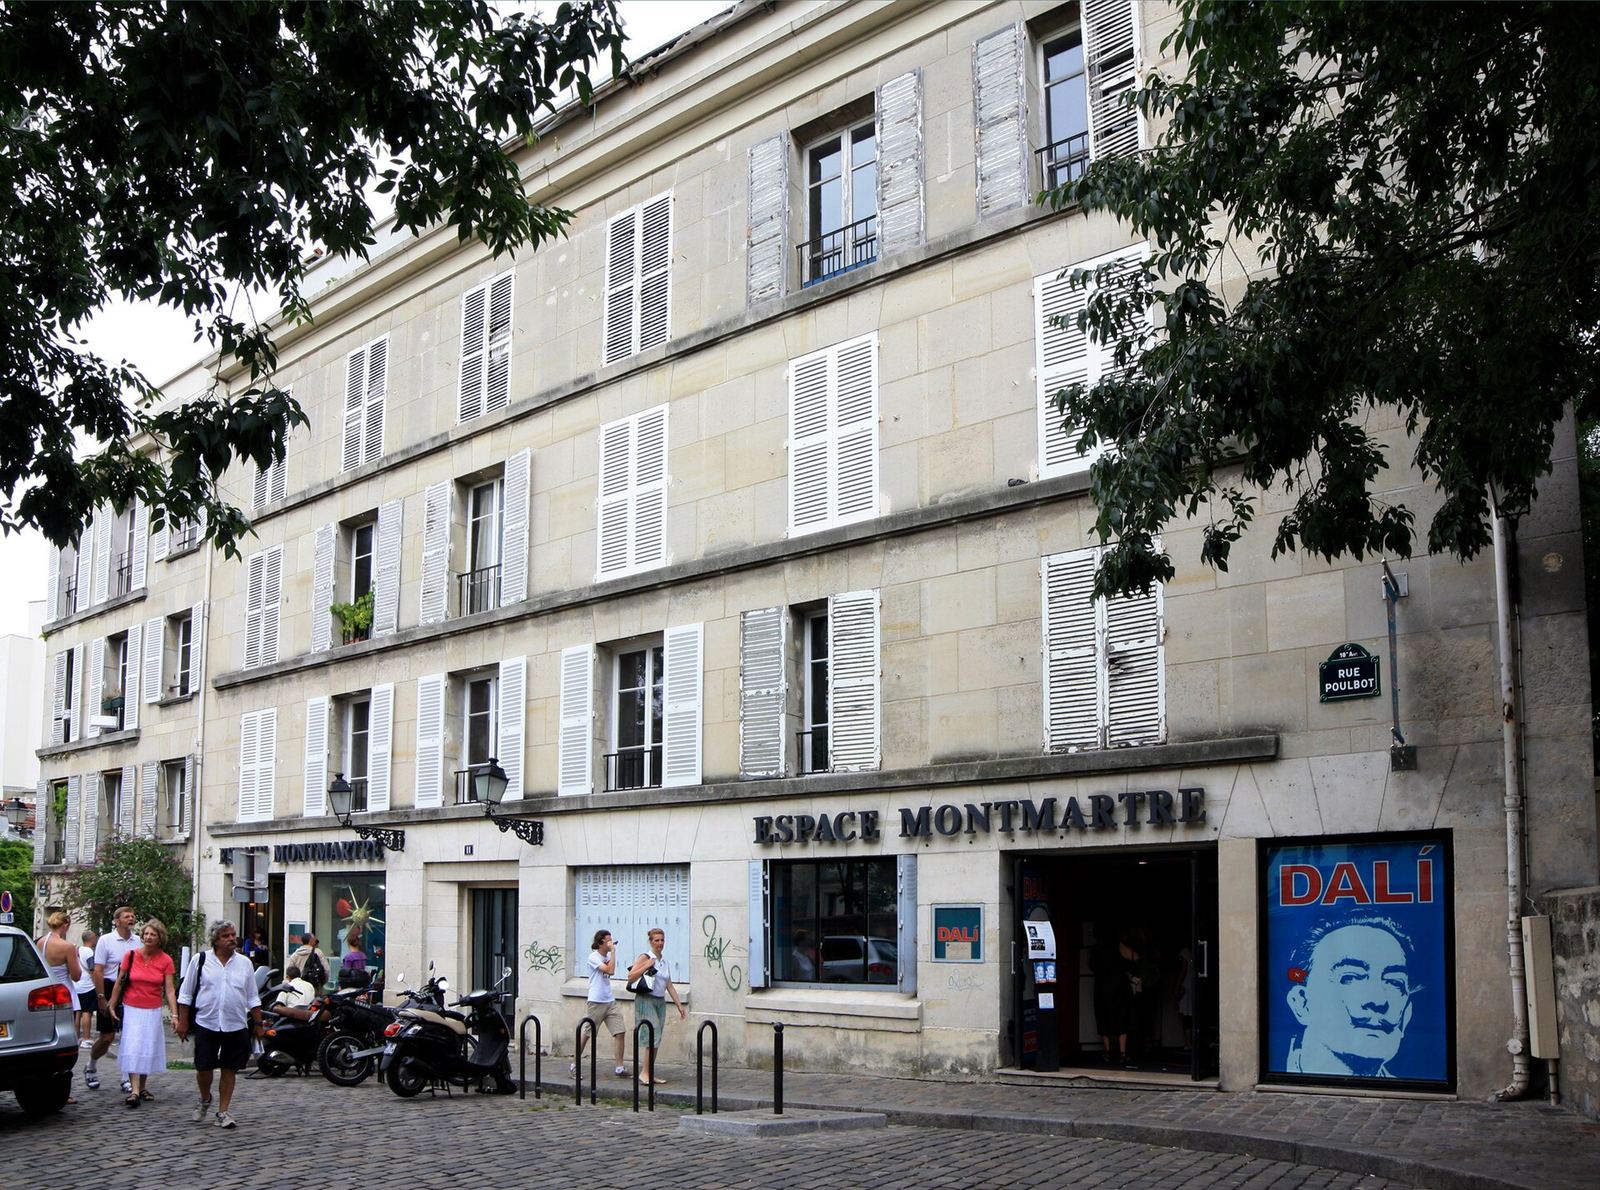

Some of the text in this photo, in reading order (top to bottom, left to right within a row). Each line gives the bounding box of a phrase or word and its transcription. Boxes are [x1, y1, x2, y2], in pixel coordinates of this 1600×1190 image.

[1338, 667, 1361, 679] RUE
[1325, 678, 1375, 693] POULBOT
[752, 787, 1207, 844] ESPACE MONTMARTRE
[273, 840, 385, 863] MONTMARTRE
[1279, 844, 1436, 907] DALÍ
[936, 924, 979, 942] DALÍ
